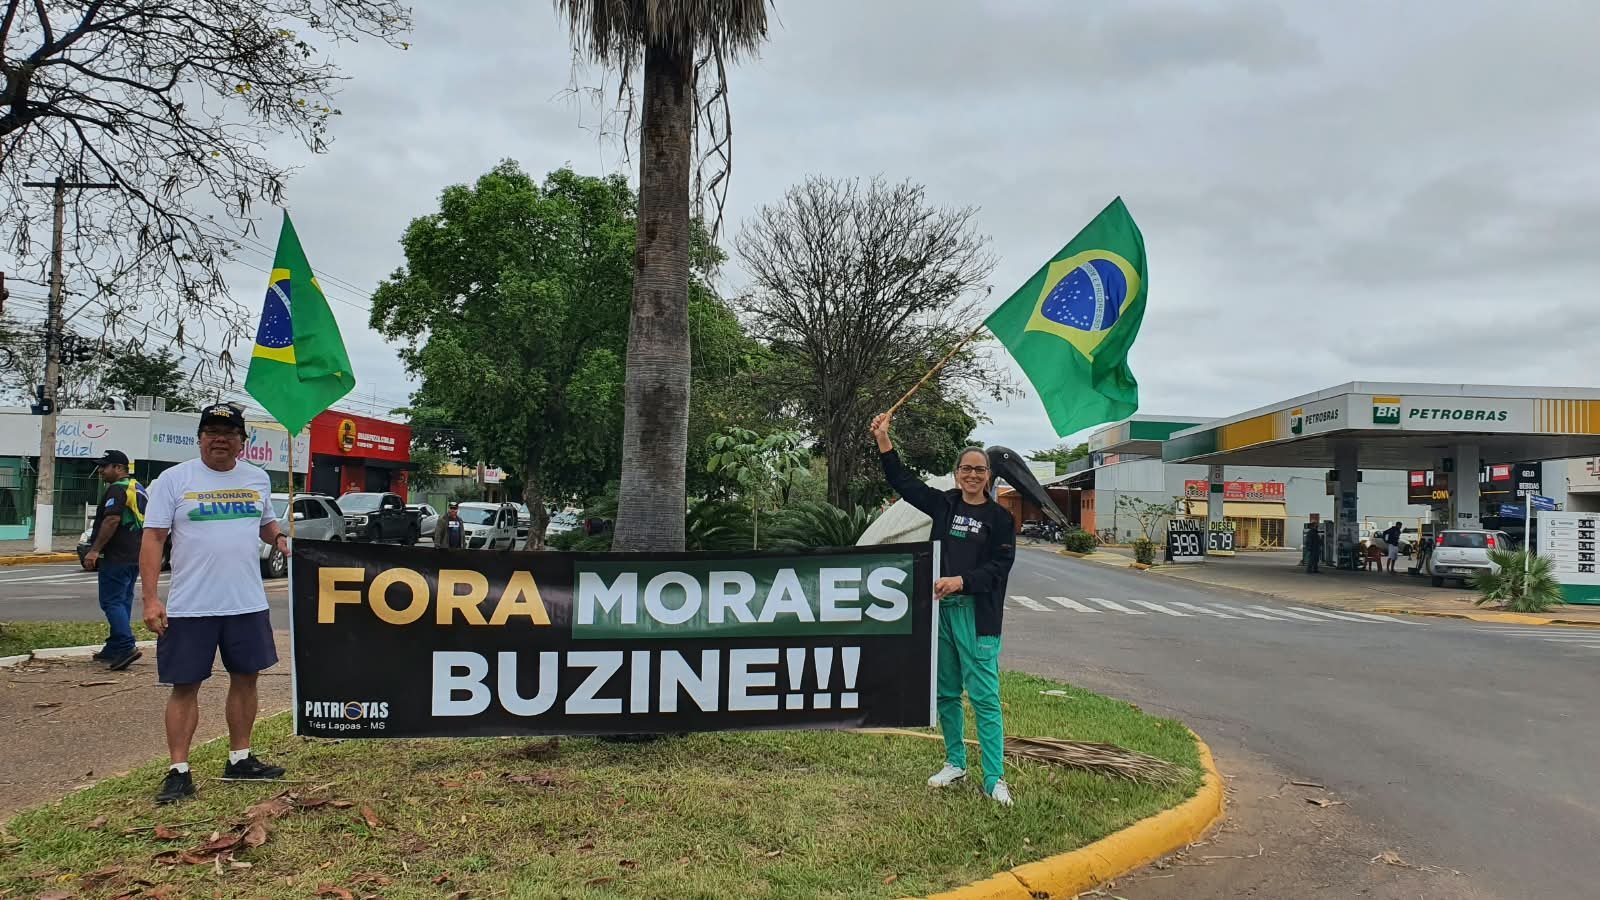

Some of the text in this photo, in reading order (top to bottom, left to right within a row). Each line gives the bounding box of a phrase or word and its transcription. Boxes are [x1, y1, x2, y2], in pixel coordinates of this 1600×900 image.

[1305, 409, 1339, 425] PETROBRAS
[1376, 406, 1508, 421] BR PETROBRAS
[238, 440, 273, 461] plash
[200, 501, 257, 515] LIVRE
[1170, 519, 1198, 531] ETANOL
[1211, 521, 1235, 530] DIESEL
[318, 566, 909, 625] FORA MORAES
[432, 647, 861, 716] BUZINE!!!
[305, 701, 389, 720] PATRIOTAS
[308, 721, 326, 730] Três
[329, 722, 361, 731] Lagoas
